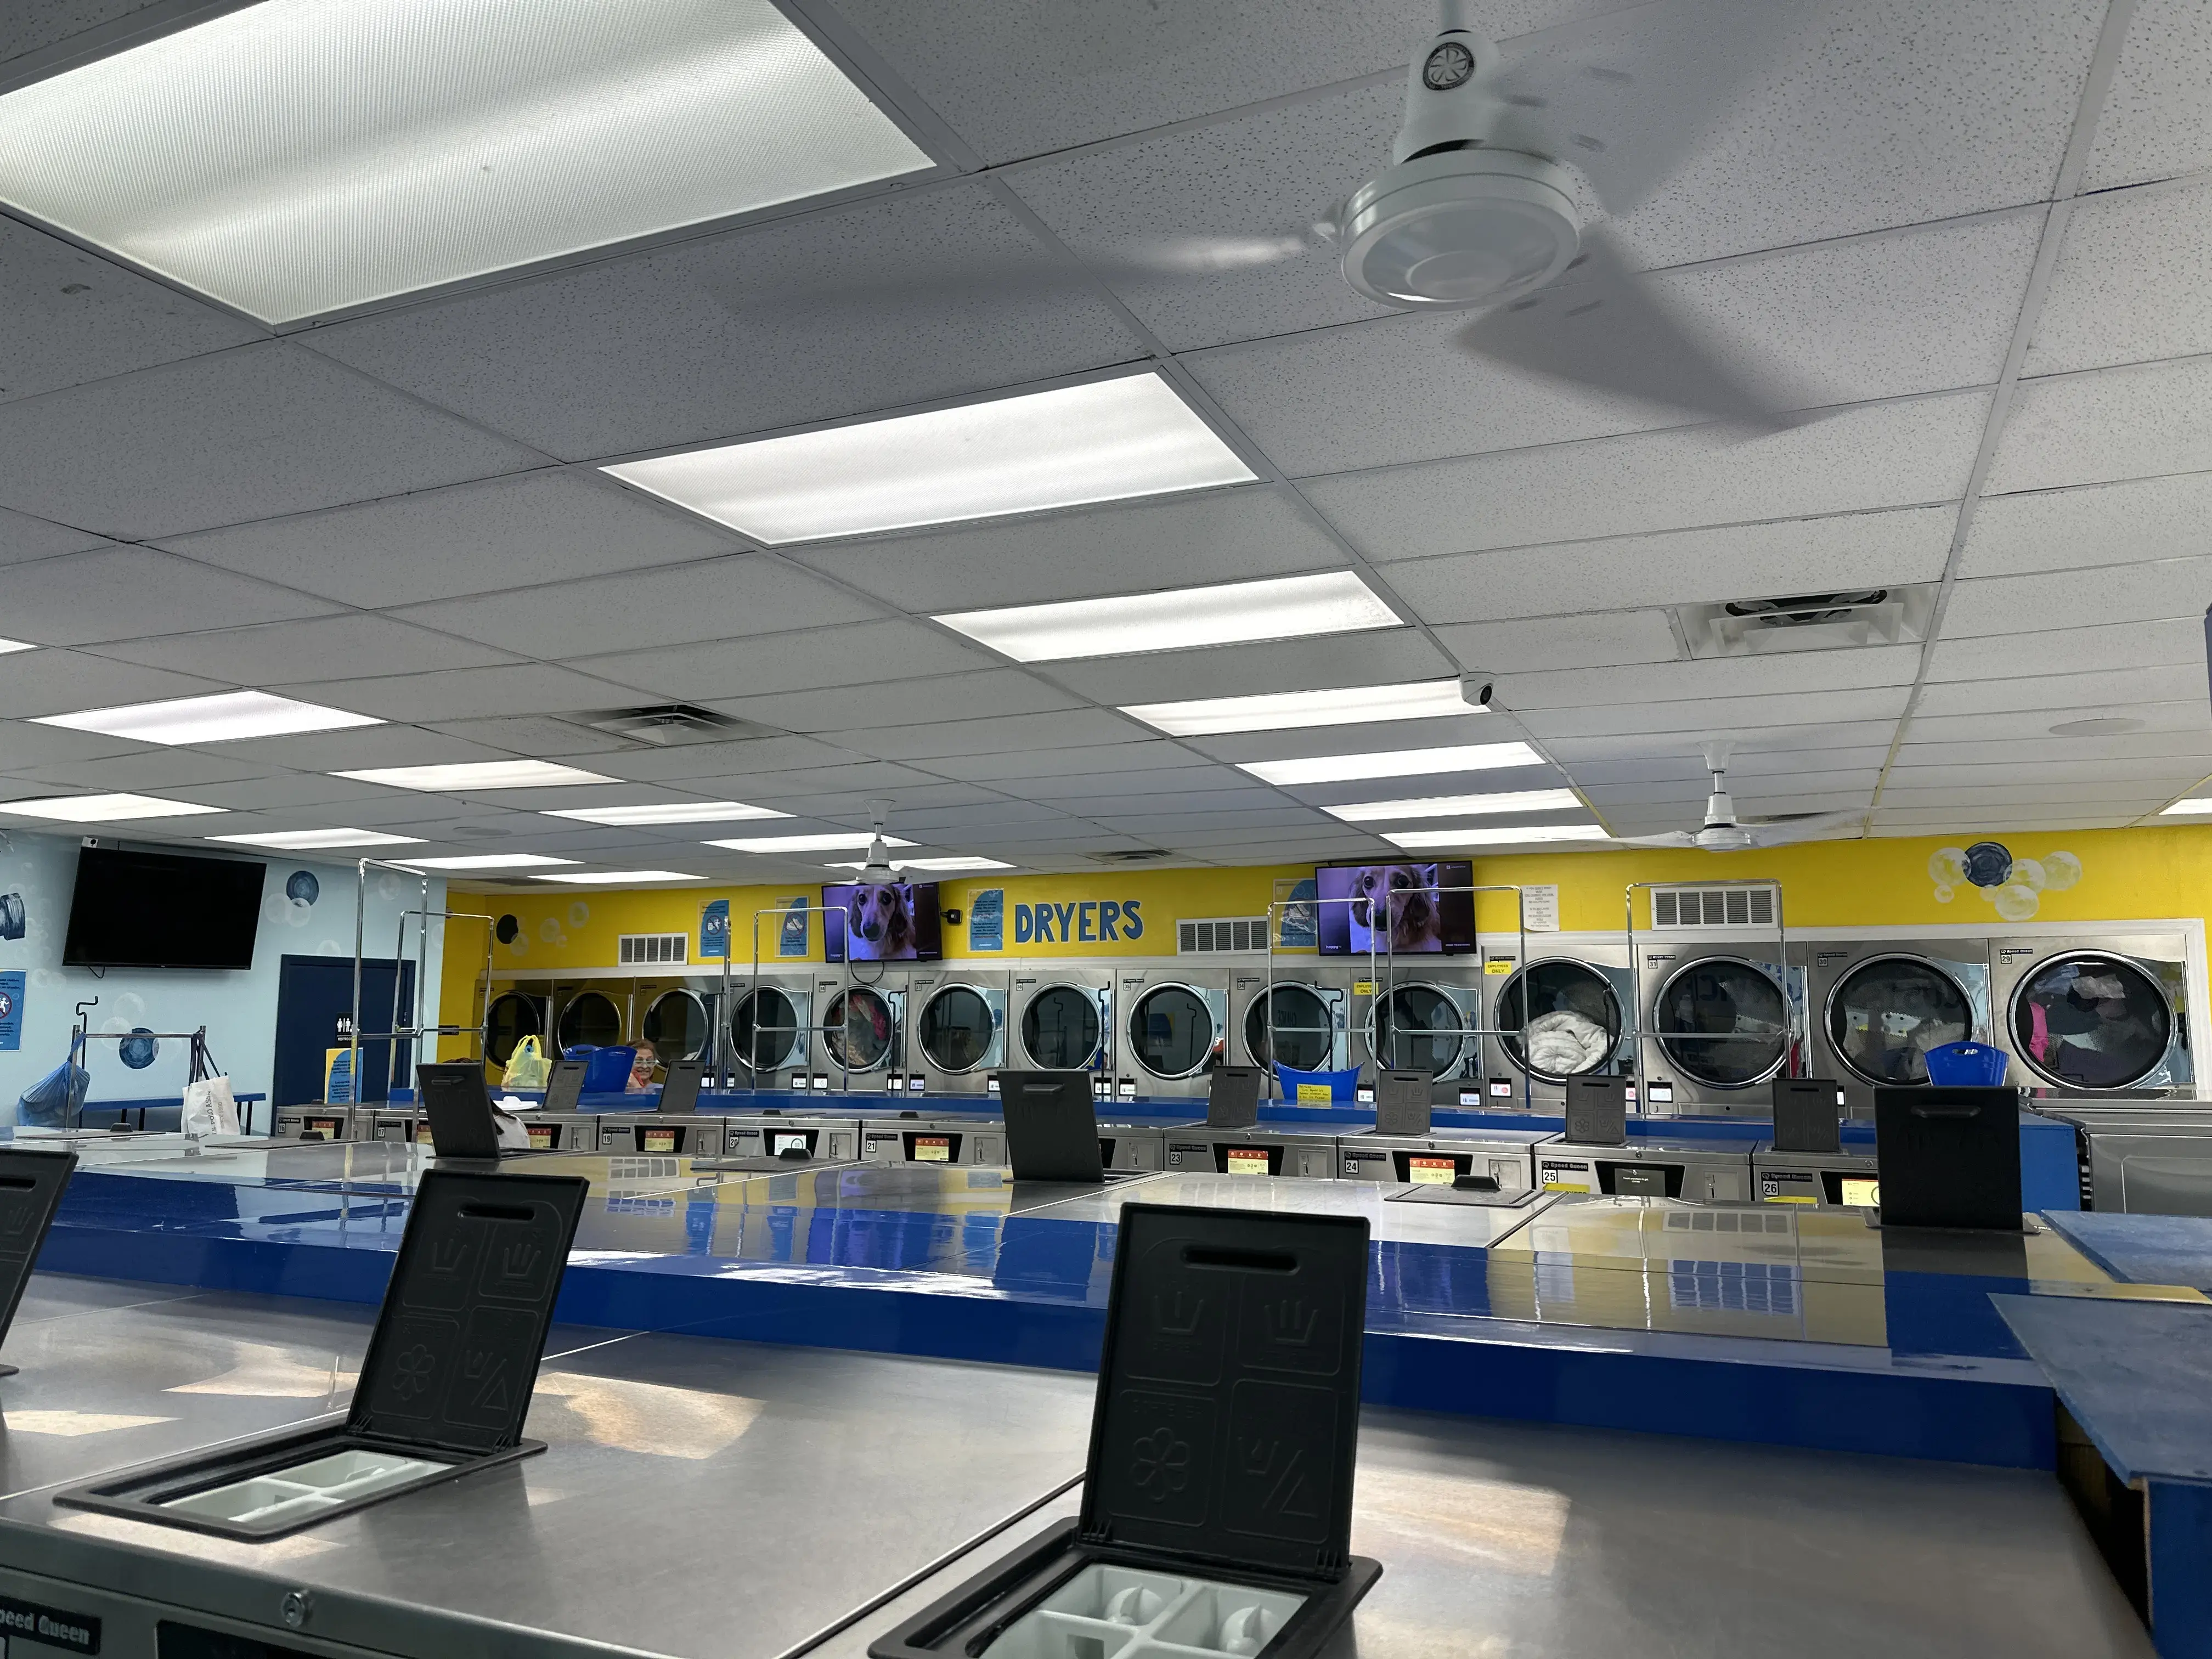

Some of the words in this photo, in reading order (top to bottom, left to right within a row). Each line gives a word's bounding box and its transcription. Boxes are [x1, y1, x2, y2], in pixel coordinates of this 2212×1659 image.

[1015, 900, 1144, 943] DRYERS
[207, 1109, 215, 1125] POLO
[1171, 1154, 1181, 1162] 23
[1346, 1162, 1357, 1171] 24
[1544, 1172, 1556, 1181] 25
[1764, 1183, 1777, 1193] 26
[38, 1615, 90, 1645] Queen
